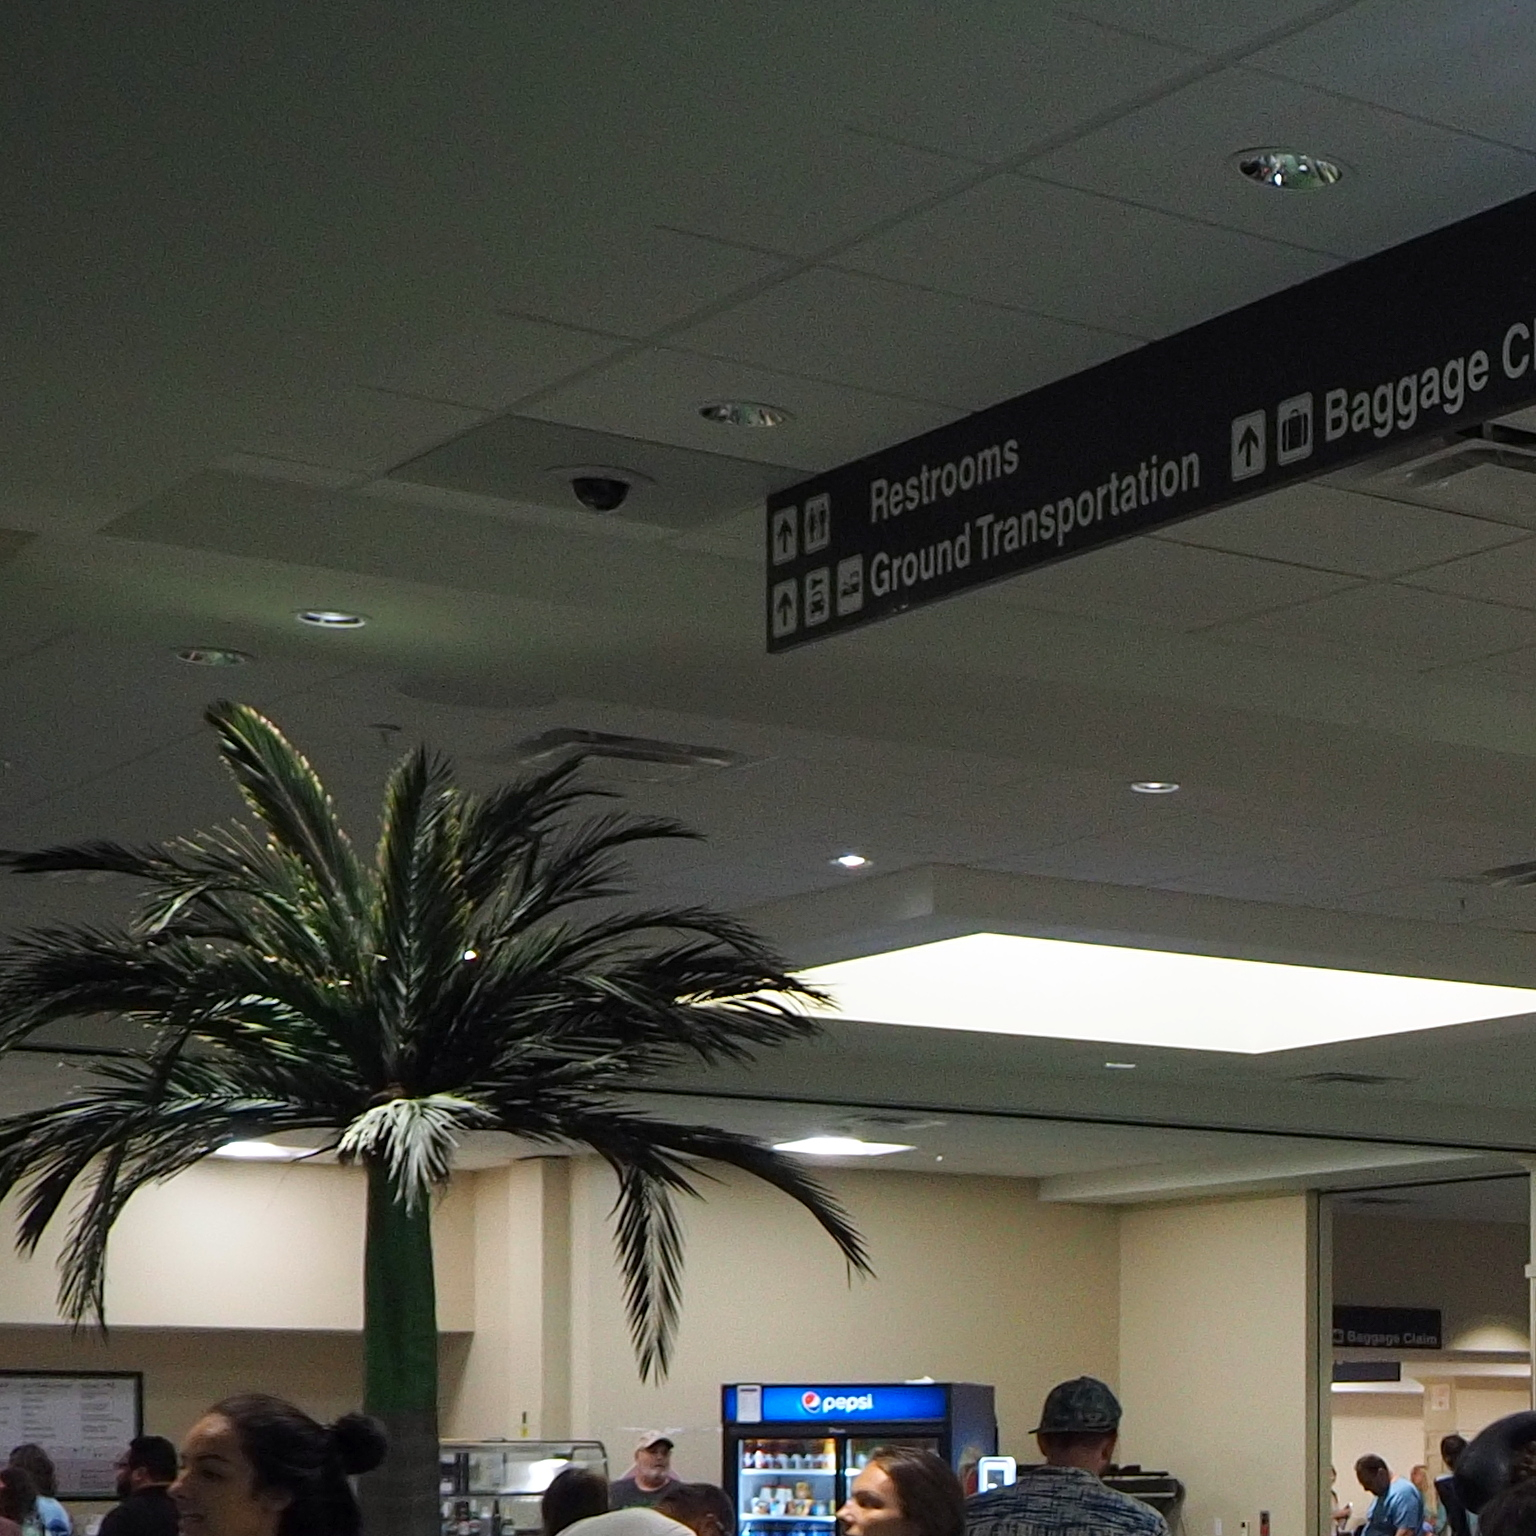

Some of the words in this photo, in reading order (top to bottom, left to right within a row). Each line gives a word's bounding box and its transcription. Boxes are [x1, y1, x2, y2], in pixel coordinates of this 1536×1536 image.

[1325, 350, 1490, 442] Baggage
[870, 439, 1020, 523] Restrooms
[870, 522, 971, 597] Ground
[975, 451, 1200, 547] Transportation
[1346, 1330, 1400, 1346] Baggage
[1402, 1332, 1438, 1345] Claim
[822, 1393, 874, 1413] pepsi
